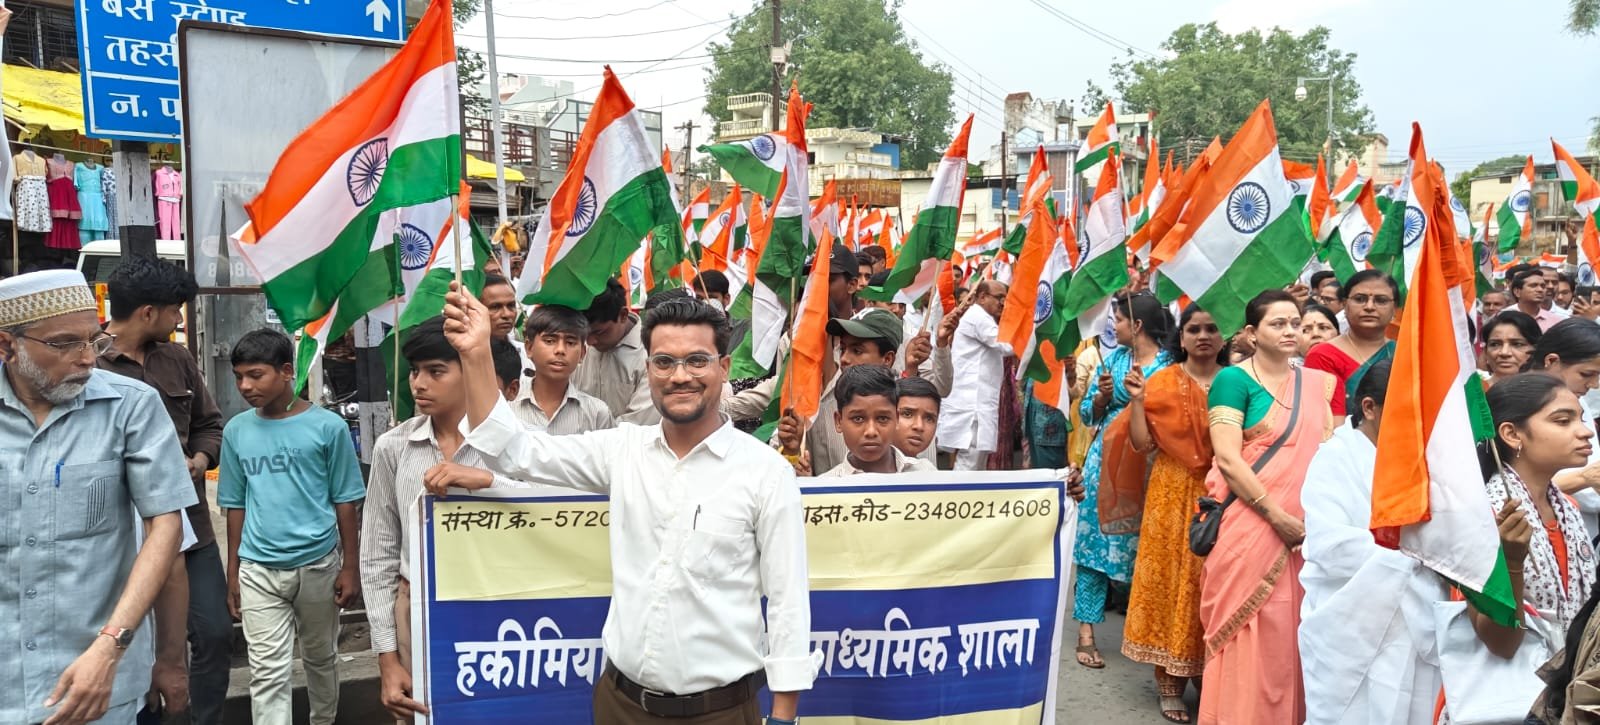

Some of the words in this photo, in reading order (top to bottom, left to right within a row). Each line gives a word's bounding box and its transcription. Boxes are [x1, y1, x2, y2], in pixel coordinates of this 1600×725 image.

[101, 0, 153, 22] बस
[108, 92, 148, 118] न.
[240, 454, 302, 476] NASA
[441, 506, 504, 532] संस्था
[804, 498, 1051, 526] ाइस.कोड-23480214608
[454, 616, 606, 697] हकीमिया
[958, 618, 1040, 677] शाला
